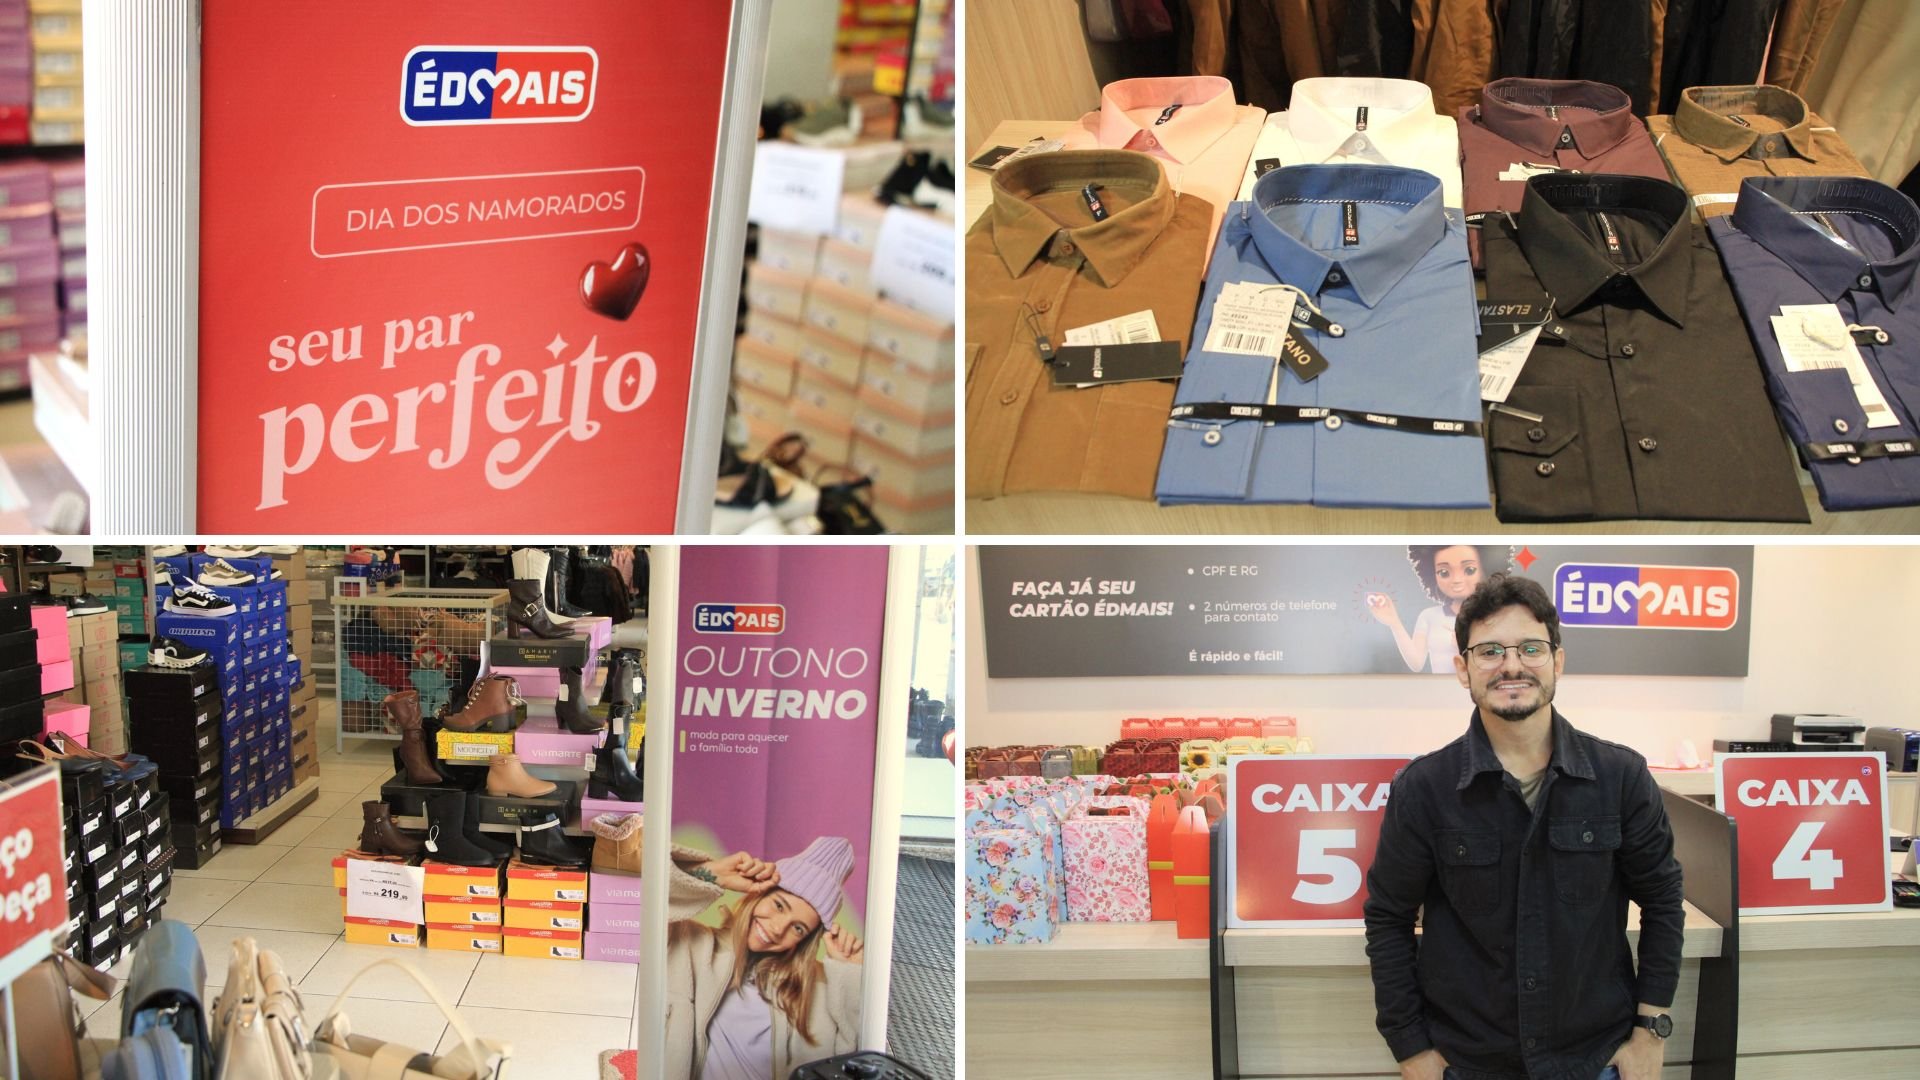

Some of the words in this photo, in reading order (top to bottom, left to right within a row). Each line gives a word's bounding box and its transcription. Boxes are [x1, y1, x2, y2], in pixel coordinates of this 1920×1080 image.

[413, 58, 586, 107] ÉDMAIS
[347, 206, 395, 232] DIA
[402, 202, 460, 228] DOS
[466, 190, 626, 223] NAMORADOS
[267, 324, 363, 373] seu
[381, 309, 475, 370] par
[255, 332, 657, 511] perfeito
[1202, 565, 1226, 576] CPF
[1229, 565, 1237, 576] E
[1241, 565, 1259, 576] RG
[1011, 581, 1064, 600] FAÇA
[1068, 577, 1093, 595] JÁ
[1098, 580, 1136, 595] SEU
[1562, 570, 1730, 617] ÉDMAIS
[698, 607, 781, 629] ÉDMAIS
[1009, 599, 1090, 617] CARTÃO
[1094, 599, 1174, 617] ÉDMAIS!
[1204, 602, 1211, 612] 2
[1215, 601, 1267, 612] números
[1270, 601, 1285, 611] de
[1289, 600, 1337, 611] telefone
[1204, 614, 1230, 624] para
[1233, 612, 1279, 623] contato
[683, 645, 868, 679] OUTONO
[1189, 649, 1197, 662] É
[1201, 650, 1240, 663] rápido
[1243, 653, 1251, 661] e
[1254, 651, 1283, 662] fácil!
[680, 686, 868, 720] INVERNO
[690, 731, 719, 740] moda
[721, 733, 745, 742] para
[747, 733, 789, 743] aquecer
[698, 743, 733, 753] família
[735, 744, 759, 754] toda
[1251, 782, 1391, 813] CAIXA
[1737, 778, 1871, 807] CAIXA
[1291, 829, 1362, 905] 5
[1772, 821, 1844, 891] 4
